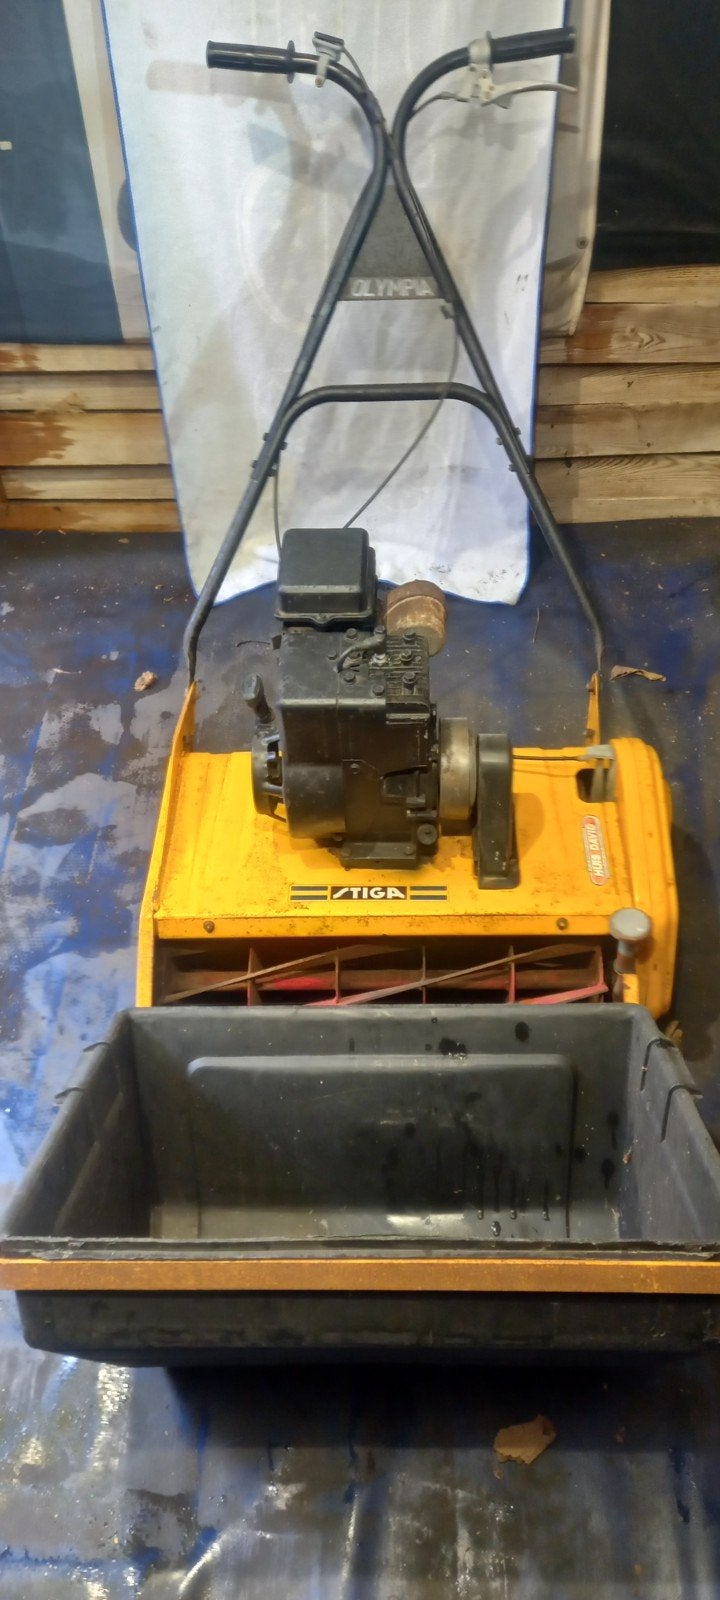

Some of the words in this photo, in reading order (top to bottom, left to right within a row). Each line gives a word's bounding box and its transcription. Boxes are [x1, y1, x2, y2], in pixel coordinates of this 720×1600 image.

[351, 279, 435, 297] OLYMPIA
[586, 824, 599, 851] DAVID
[591, 854, 604, 877] HUIS
[332, 887, 406, 899] STIGA
